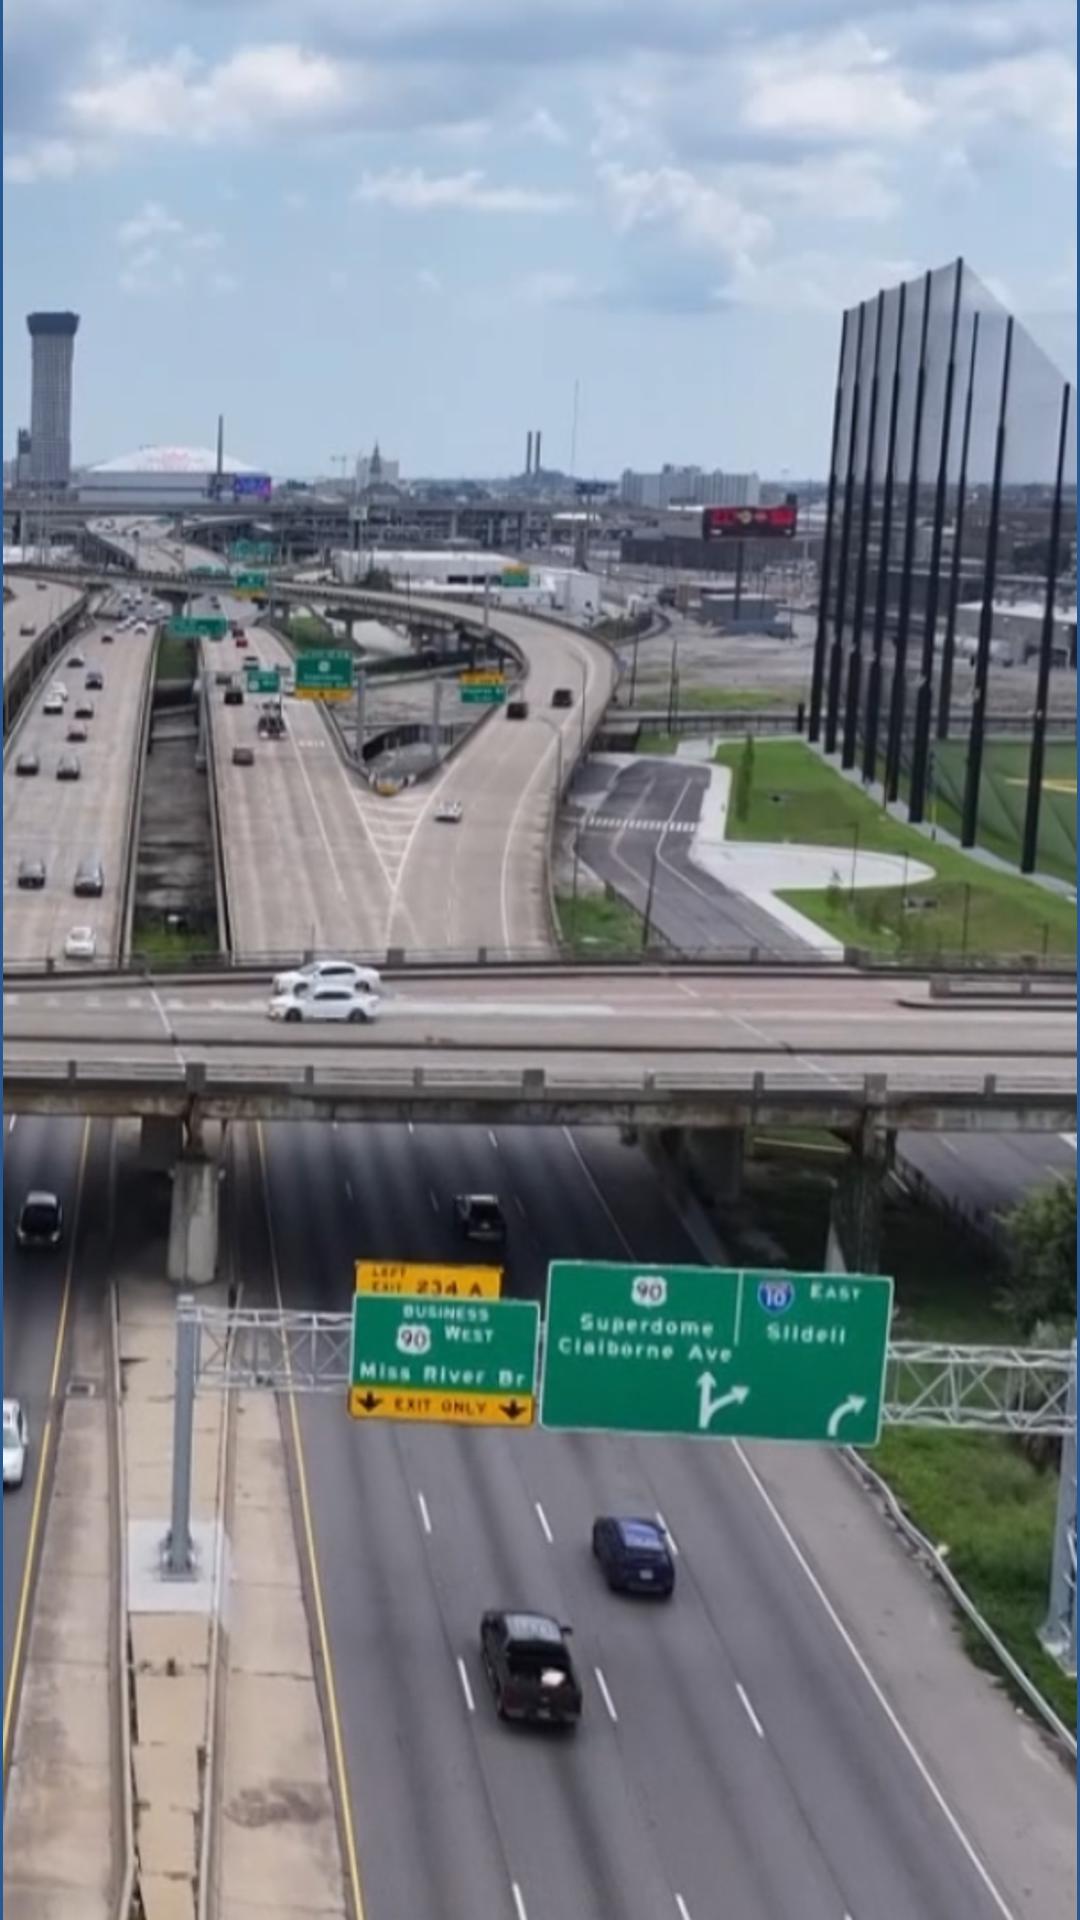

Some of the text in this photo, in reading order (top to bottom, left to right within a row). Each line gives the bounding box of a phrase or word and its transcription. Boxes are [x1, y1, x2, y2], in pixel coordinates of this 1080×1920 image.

[371, 1265, 407, 1278] LEFT
[416, 1279, 459, 1295] 234
[470, 1282, 483, 1297] A
[635, 1280, 663, 1300] 90
[765, 1289, 787, 1307] 10
[403, 1304, 489, 1322] BUSINESS
[580, 1313, 715, 1338] Superdome
[766, 1322, 846, 1345] Slidell
[400, 1329, 427, 1347] 90
[557, 1336, 732, 1363] Claiborne Ave
[359, 1361, 527, 1388] Miss River Br
[394, 1397, 488, 1414] EXIT ONLY
